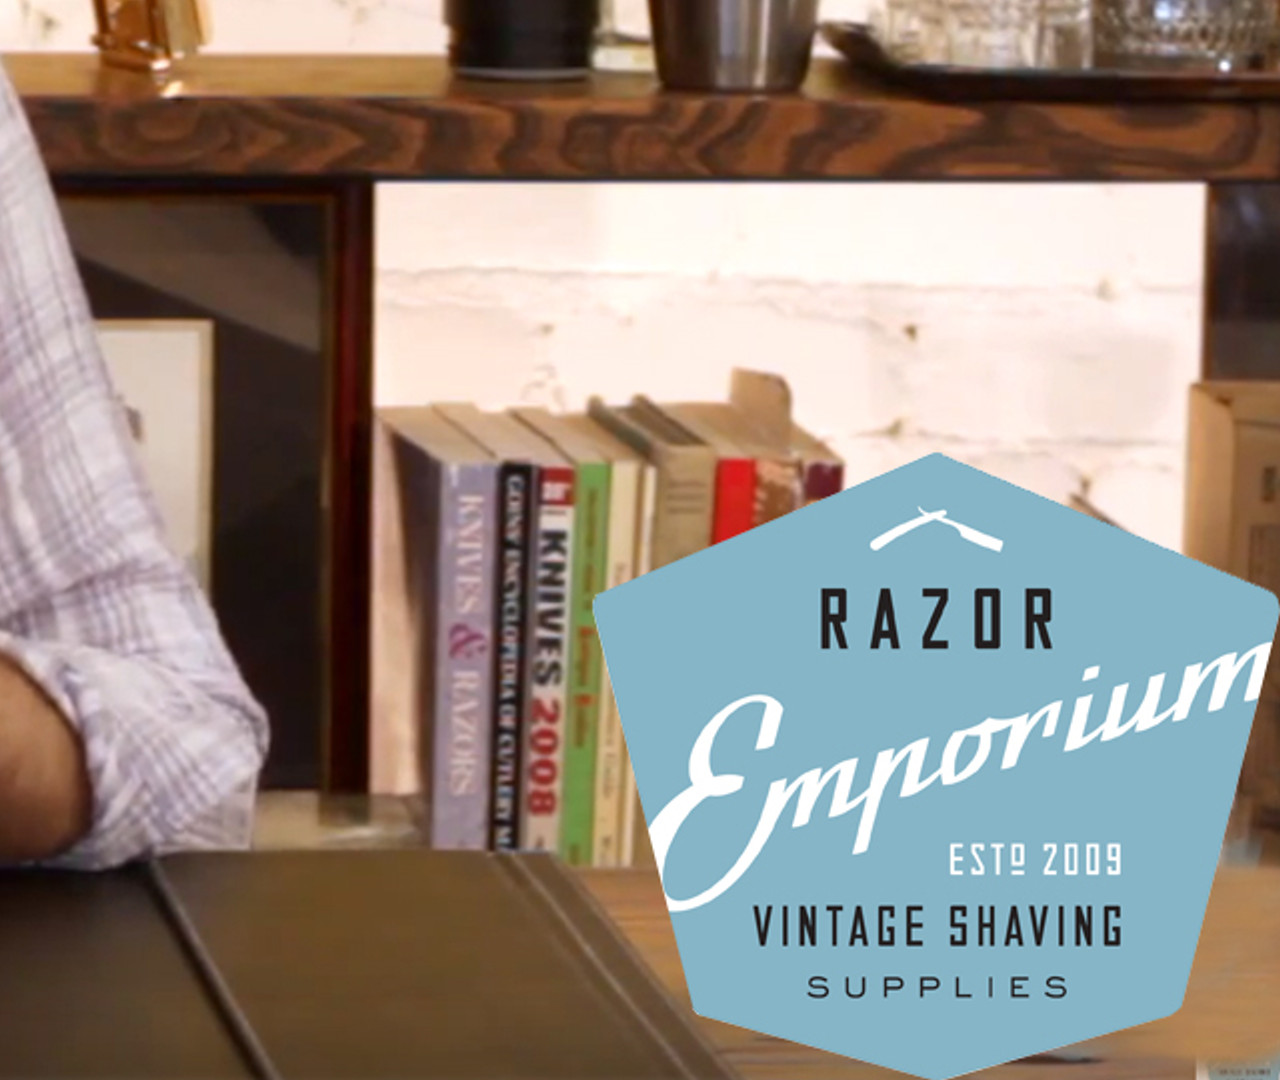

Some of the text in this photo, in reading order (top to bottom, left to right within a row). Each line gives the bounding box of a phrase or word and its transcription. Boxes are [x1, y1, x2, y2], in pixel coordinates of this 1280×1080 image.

[455, 494, 485, 614] KNIVES
[533, 530, 568, 687] KNIVES
[449, 671, 481, 797] RAZORS
[528, 698, 561, 817] 2008
